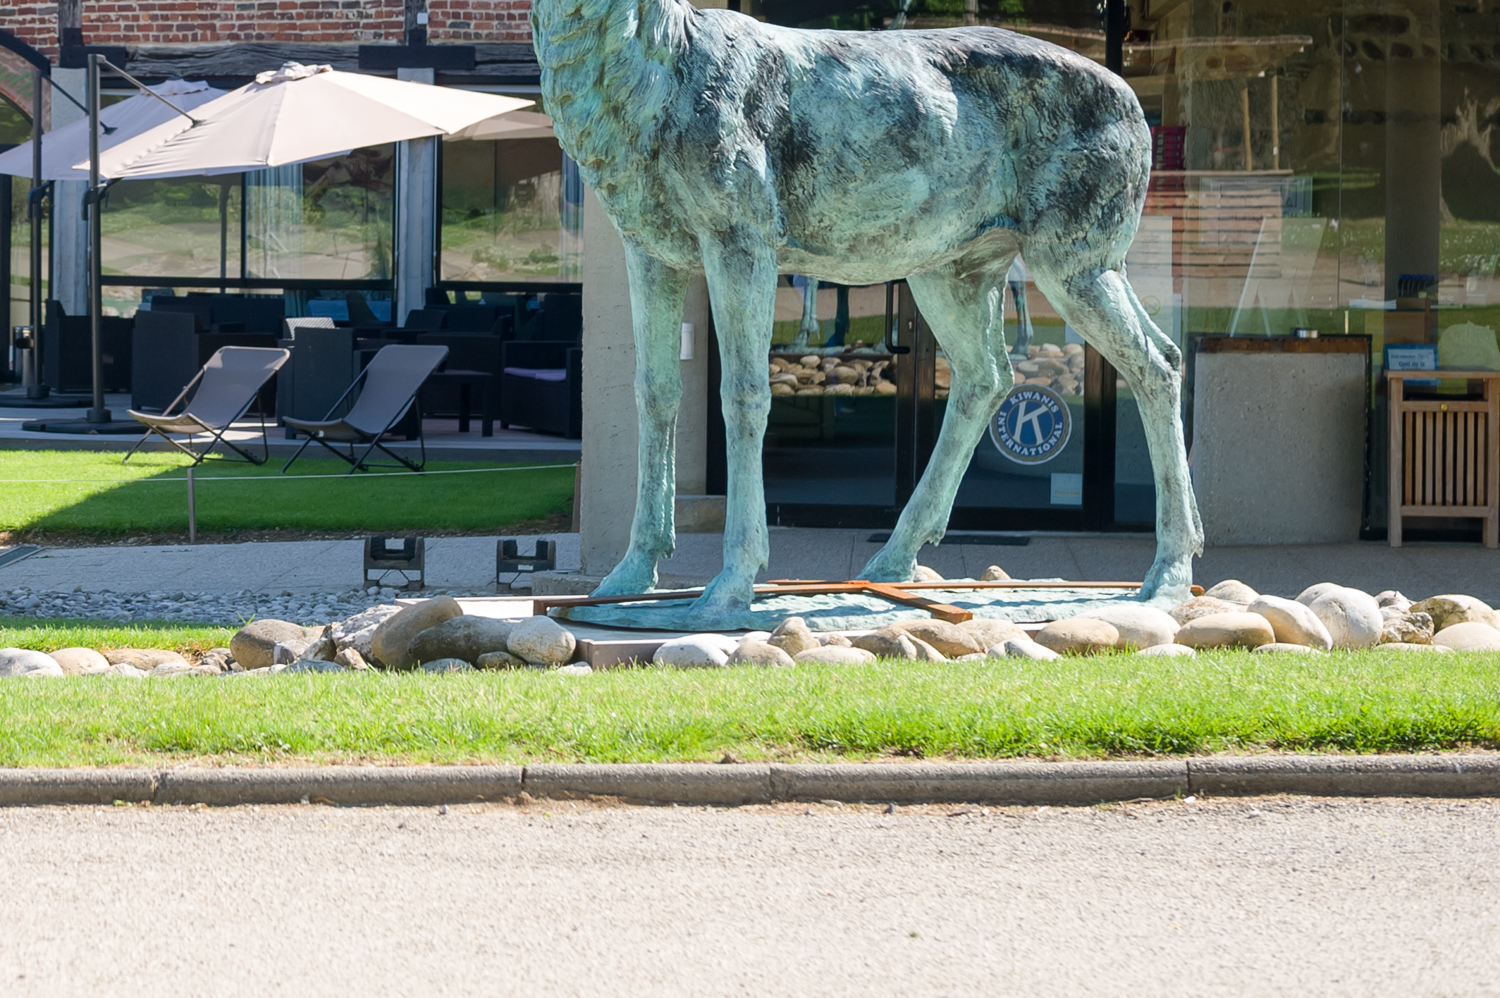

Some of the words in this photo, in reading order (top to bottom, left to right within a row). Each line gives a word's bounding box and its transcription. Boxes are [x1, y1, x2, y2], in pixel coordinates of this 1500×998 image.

[1009, 391, 1060, 413] KIWANIS
[1012, 401, 1049, 445] K
[997, 411, 1063, 456] INTERNATIONAL
